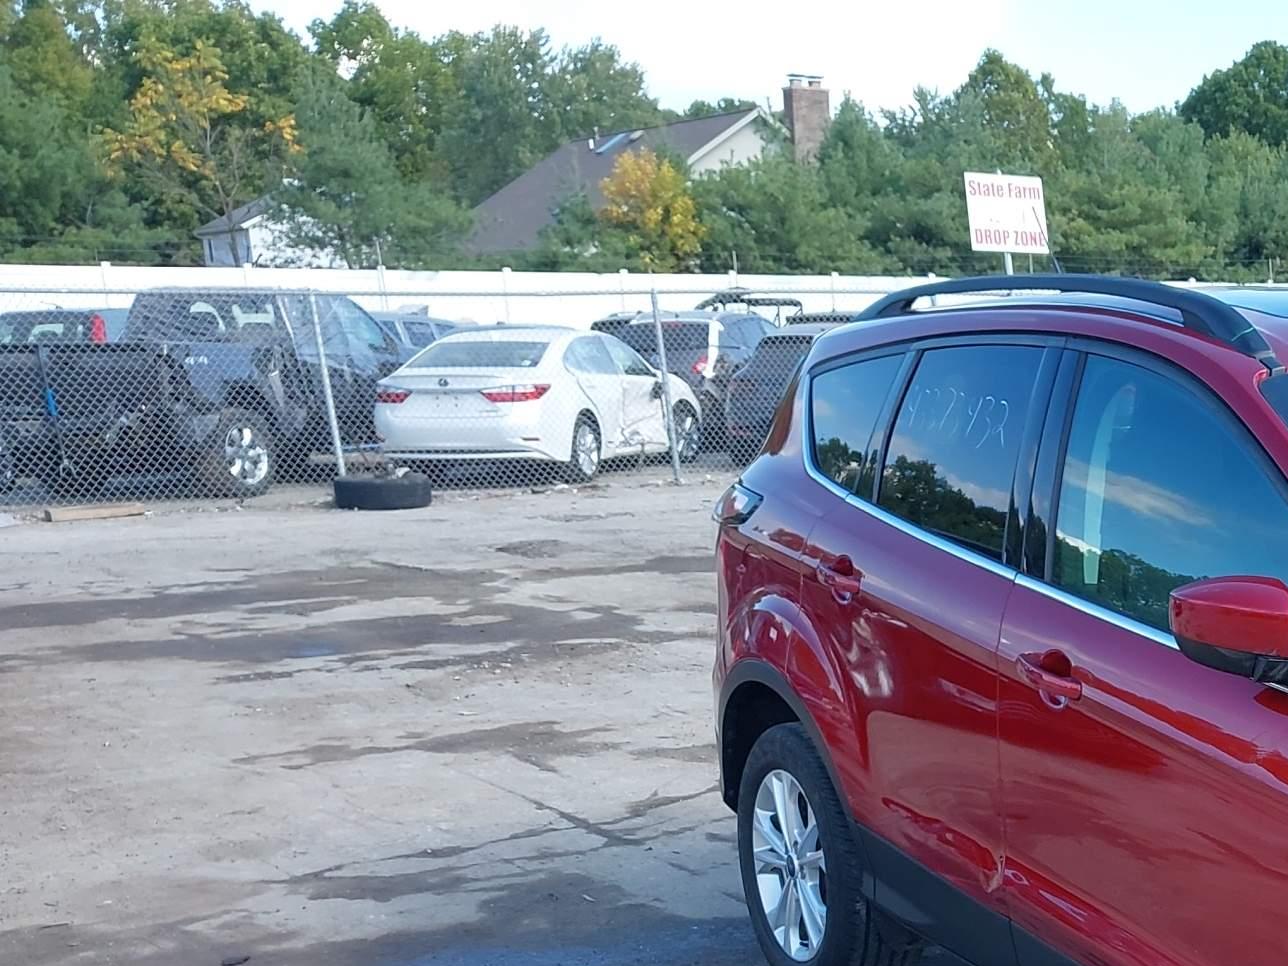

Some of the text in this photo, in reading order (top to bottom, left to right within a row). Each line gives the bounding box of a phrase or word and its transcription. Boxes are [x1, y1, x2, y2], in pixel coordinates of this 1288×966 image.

[968, 180, 1040, 200] State Farm
[975, 228, 1045, 247] DROP ZONE
[908, 384, 1010, 450] 47432
